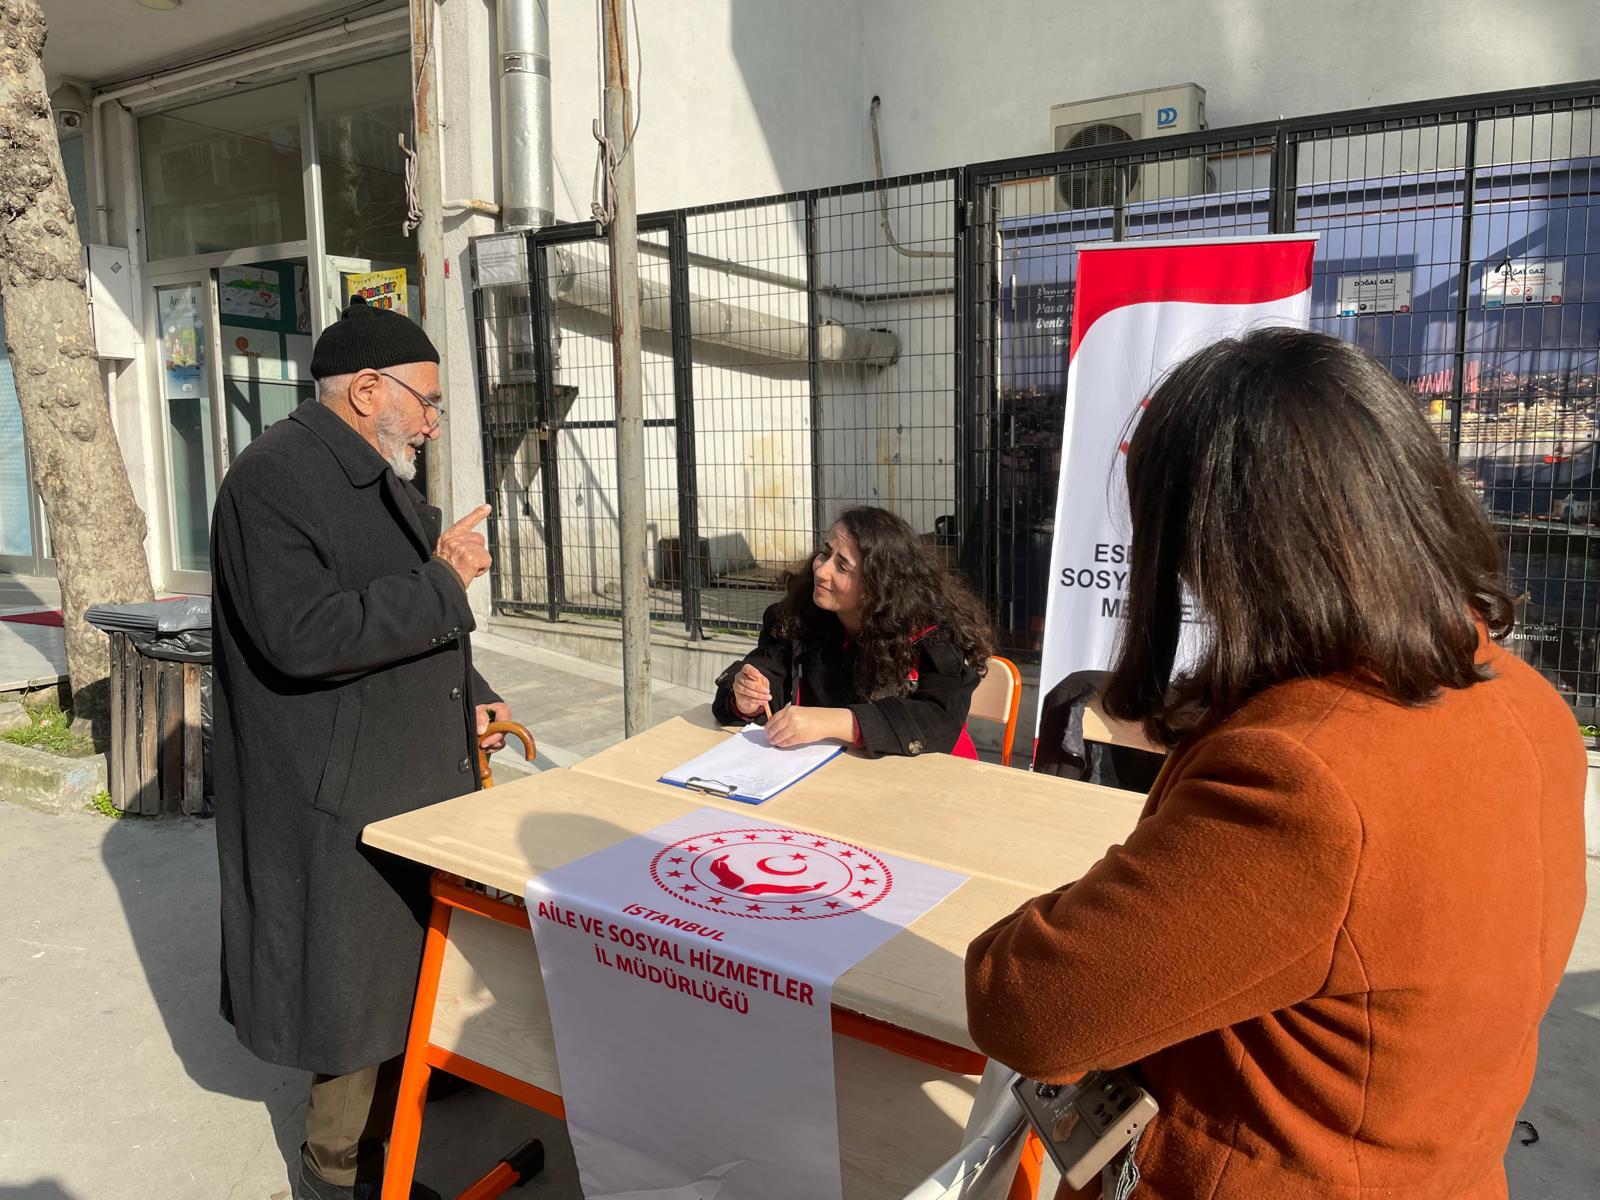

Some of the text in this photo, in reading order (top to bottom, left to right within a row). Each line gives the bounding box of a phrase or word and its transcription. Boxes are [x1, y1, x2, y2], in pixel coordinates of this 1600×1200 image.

[1354, 279, 1378, 287] DOĞAL
[1060, 567, 1129, 590] SOSY
[622, 903, 727, 942] İSTANBUL
[538, 900, 814, 1006] AİLE VE SOSYAL HİZMETLER
[594, 943, 750, 1015] İL MÜDÜRLÜĞÜ
